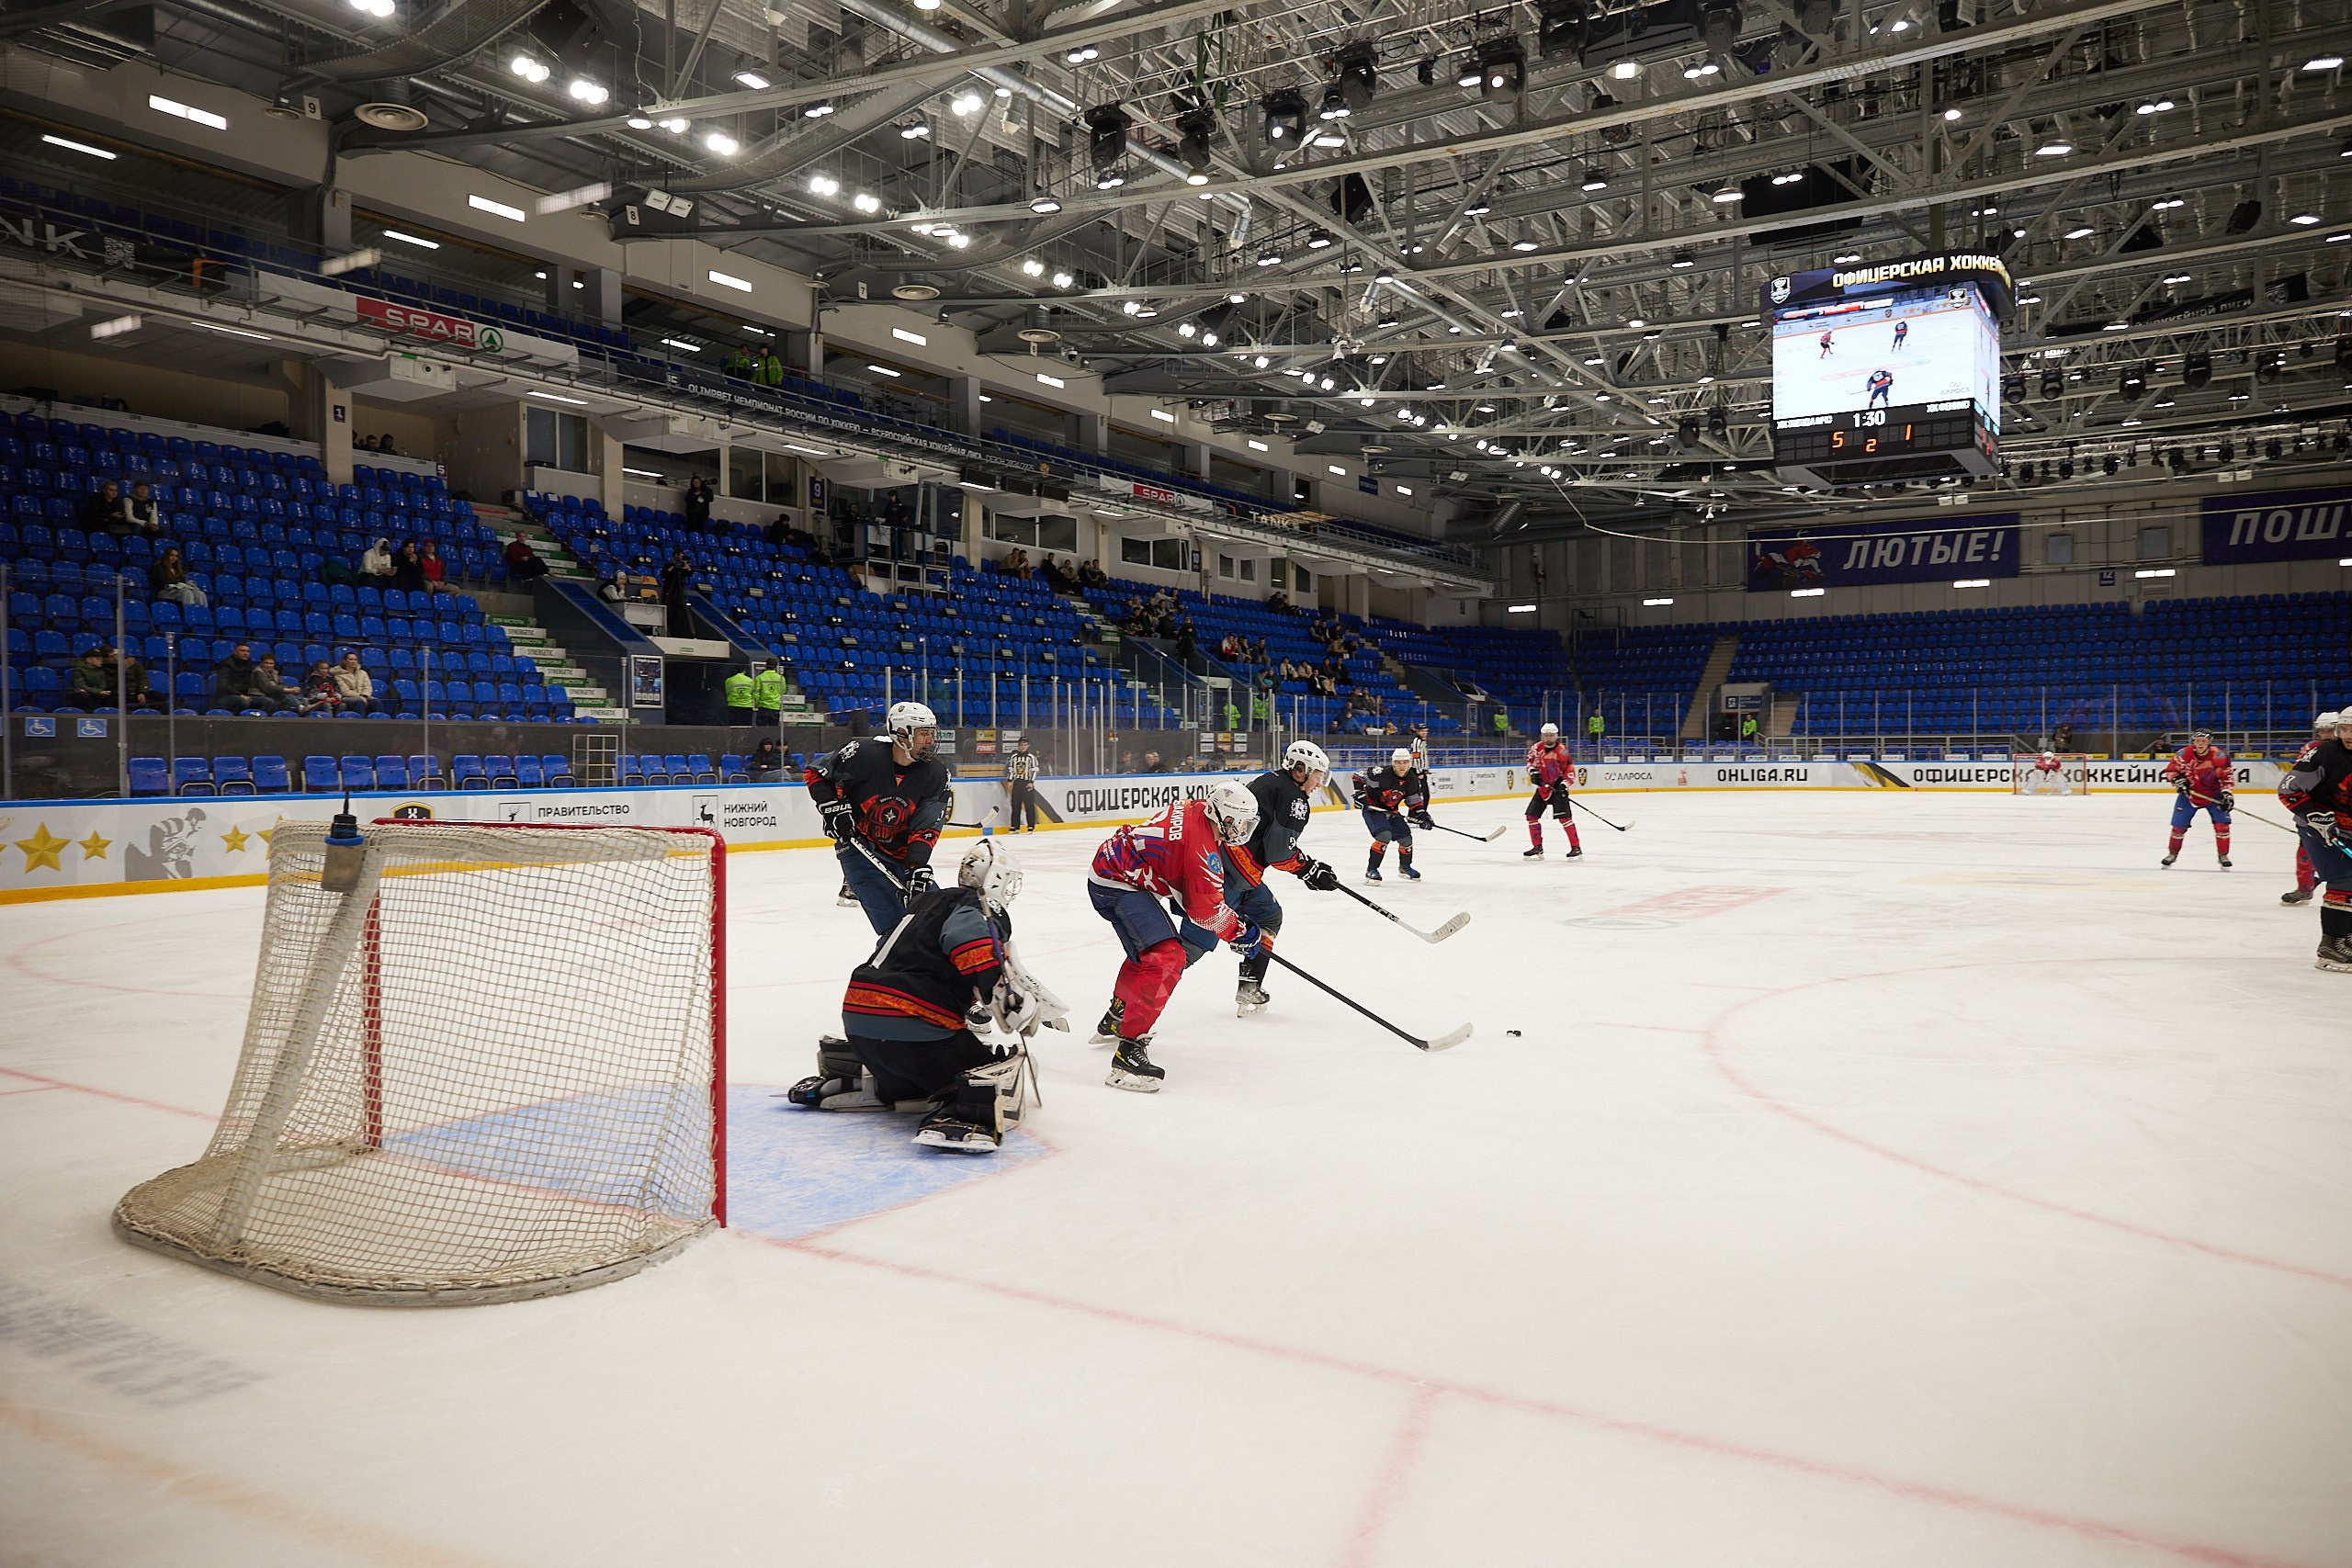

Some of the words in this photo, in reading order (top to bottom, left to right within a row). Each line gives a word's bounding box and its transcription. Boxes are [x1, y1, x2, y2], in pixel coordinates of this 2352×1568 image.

[309, 102, 317, 114] 9
[629, 210, 637, 220] 8
[1833, 258, 1944, 289] ОФИЦЕРСКАЯ
[385, 308, 473, 343] SPAR
[335, 408, 343, 418] 1
[688, 384, 732, 402] OLIMPBET
[734, 395, 783, 416] ЧЕМПИОНАТ
[786, 408, 816, 423] РОССИИ
[818, 416, 829, 426] ПО
[831, 419, 861, 434] ХОККЕЮ
[1853, 410, 1886, 428] 1:30
[1832, 431, 1844, 447] 5
[1905, 423, 1911, 441] 1
[1866, 438, 1876, 451] 2
[437, 465, 446, 475] 5
[814, 483, 821, 497] 9
[1142, 489, 1174, 504] SPAR
[2229, 506, 2352, 546] ПОШ
[1842, 530, 2006, 570] ЛЮТЫЕ!
[1717, 769, 1808, 782] OHLIGA.RU
[1914, 768, 2035, 784] ОФИЦЕРСКА
[2064, 764, 2173, 784] ХОККЕЙНА
[724, 800, 768, 814] НИЖНИЙ
[1066, 786, 1181, 814] ОФИЦЕРСКАЯ
[538, 805, 630, 818] ПРАВИТЕЛЬСТВО
[824, 803, 853, 814] BAUE
[724, 816, 776, 829] НОВГОРОД
